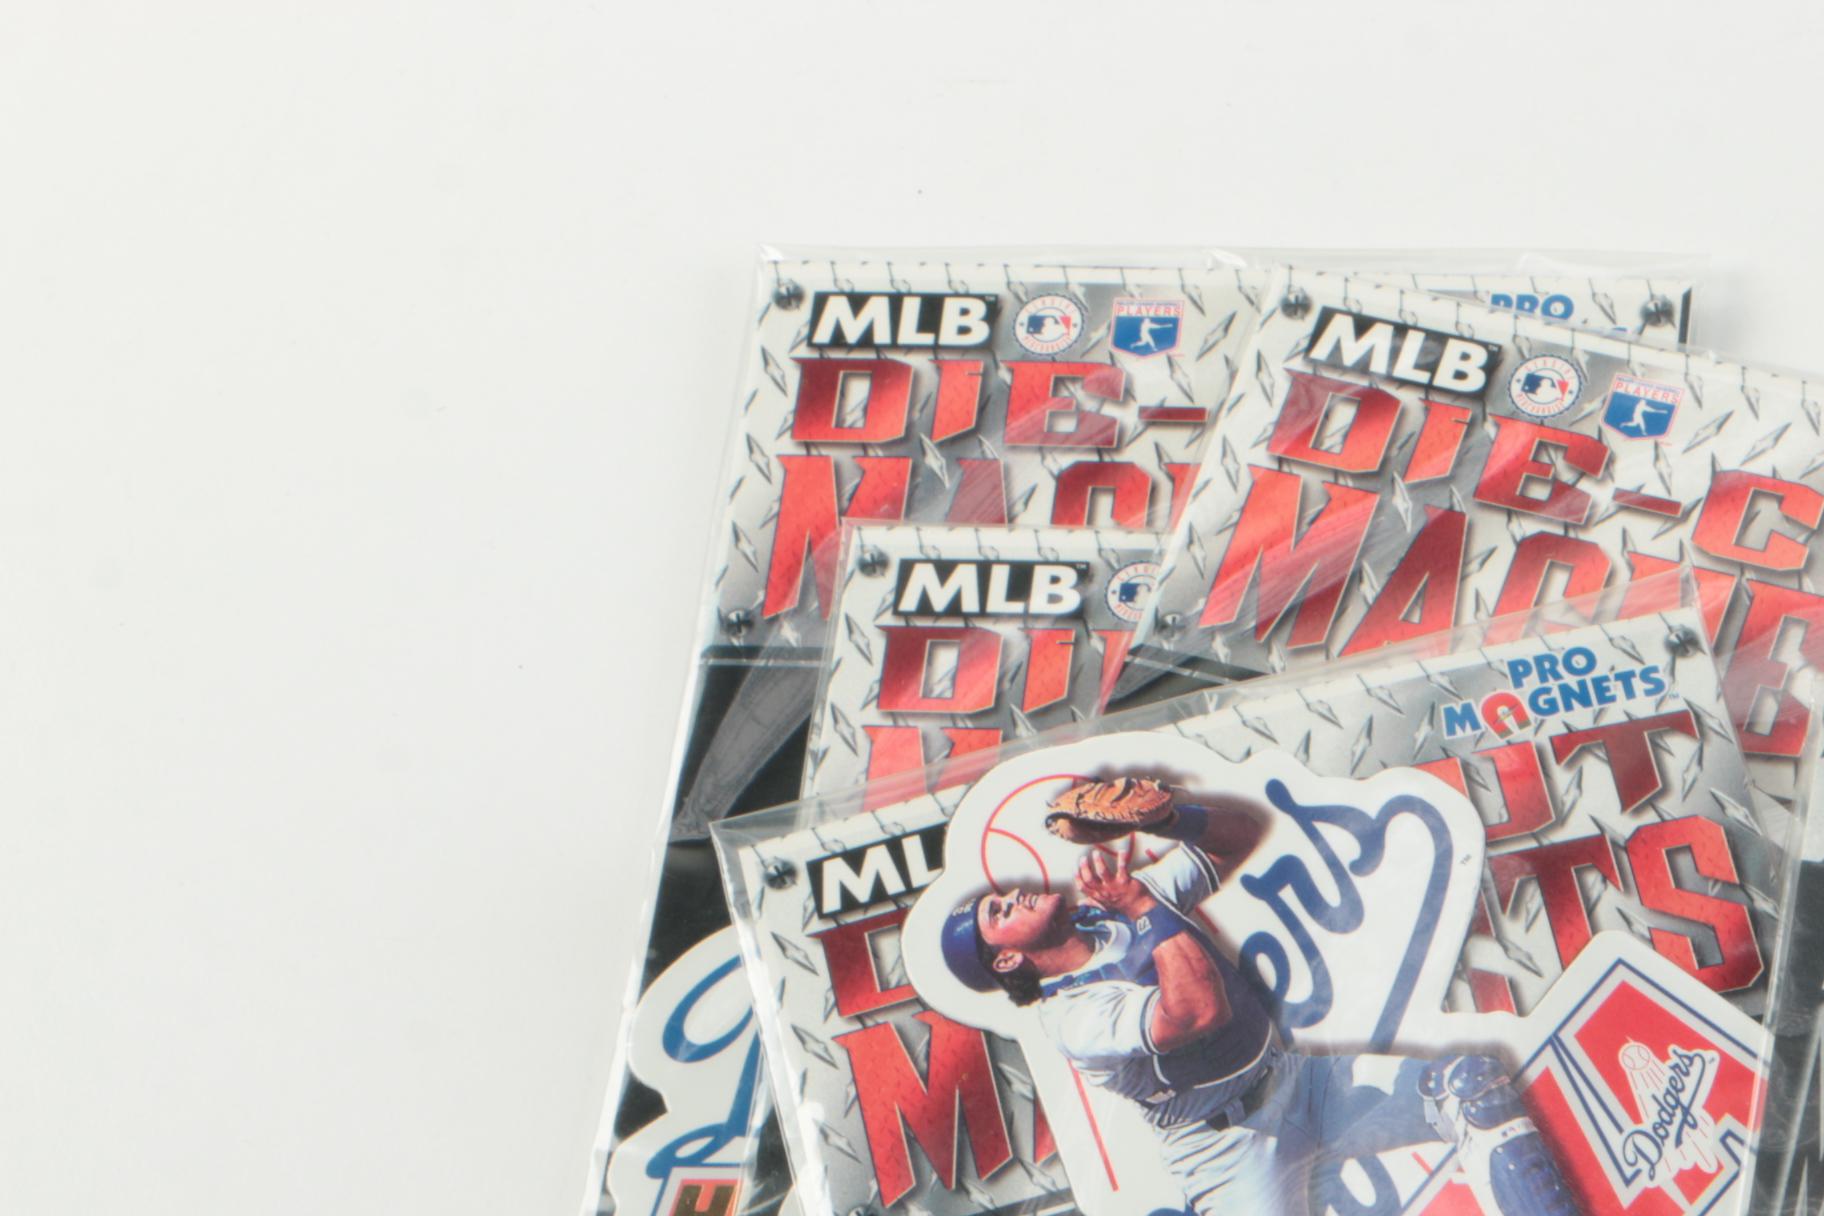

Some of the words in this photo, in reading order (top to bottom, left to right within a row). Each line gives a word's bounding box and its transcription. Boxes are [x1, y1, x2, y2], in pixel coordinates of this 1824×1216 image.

[811, 296, 992, 347] MLB
[1308, 318, 1491, 394] MLB
[898, 561, 1083, 615] MLB
[1507, 645, 1598, 690] PRO
[821, 833, 947, 914] ML
[1622, 1048, 1706, 1182] Dodgers
